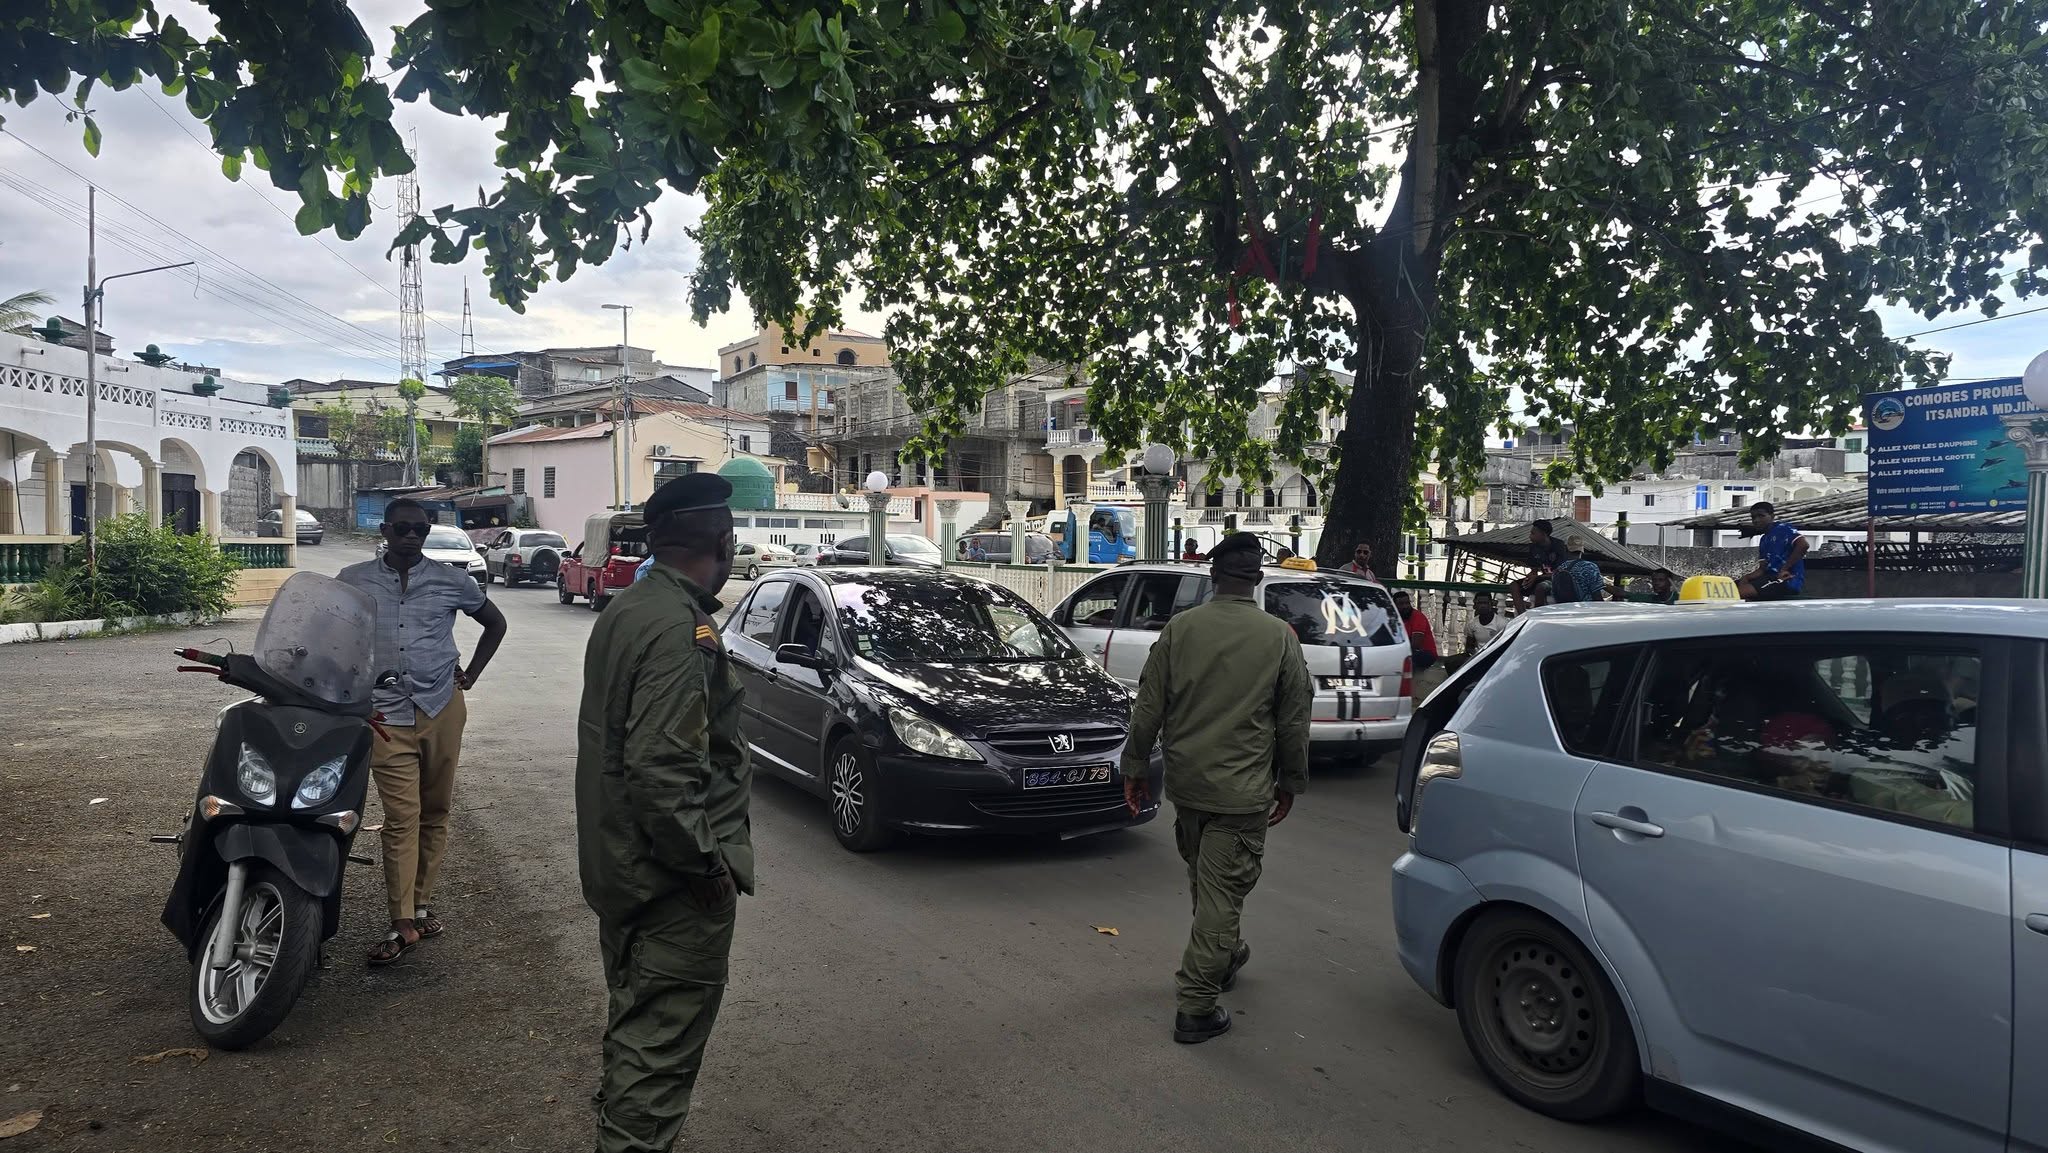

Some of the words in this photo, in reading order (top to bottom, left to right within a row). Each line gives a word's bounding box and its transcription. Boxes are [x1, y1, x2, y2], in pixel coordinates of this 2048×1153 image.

[1905, 390, 1969, 407] COMORES
[1925, 405, 1988, 421] ITSANDRA
[1993, 401, 2040, 415] MDJIN
[1938, 440, 1978, 448] DAUPHINS
[1903, 467, 1945, 475] PROMENER
[1703, 581, 1735, 598] TAXI
[1027, 771, 1061, 786] 854
[1089, 766, 1109, 780] 73
